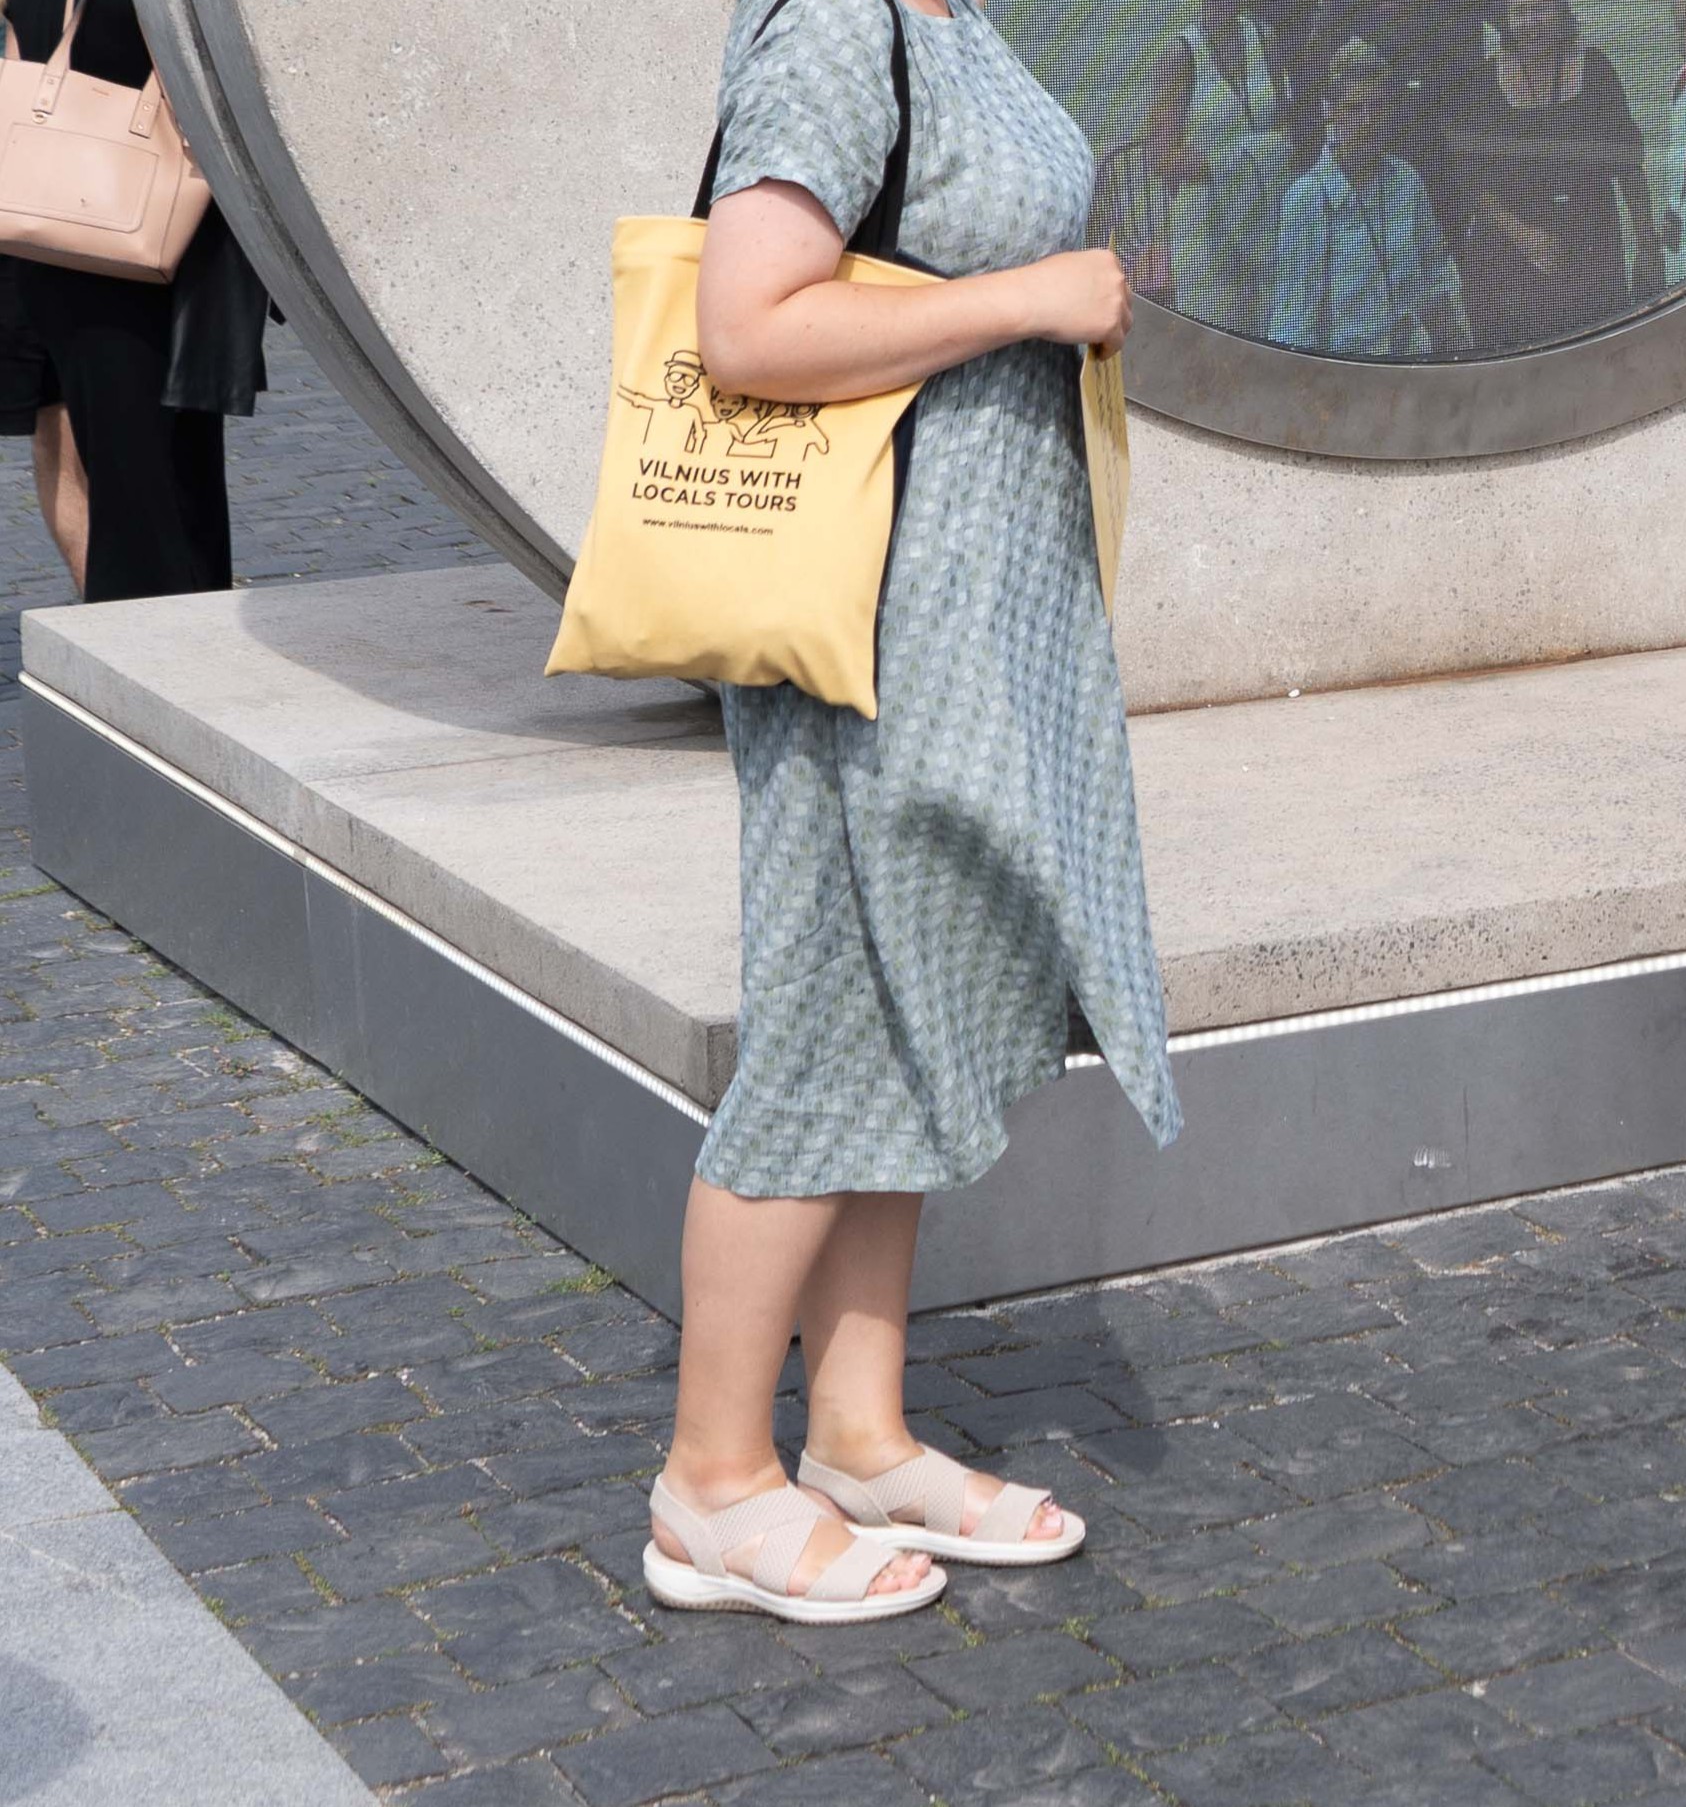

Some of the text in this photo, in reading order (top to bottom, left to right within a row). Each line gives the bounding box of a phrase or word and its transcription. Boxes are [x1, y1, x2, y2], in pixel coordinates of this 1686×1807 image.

[639, 458, 802, 490] VILNIUS WITH
[632, 482, 798, 512] LOCALS TOURS
[642, 518, 774, 536] www.vilniuswithlocals.com
